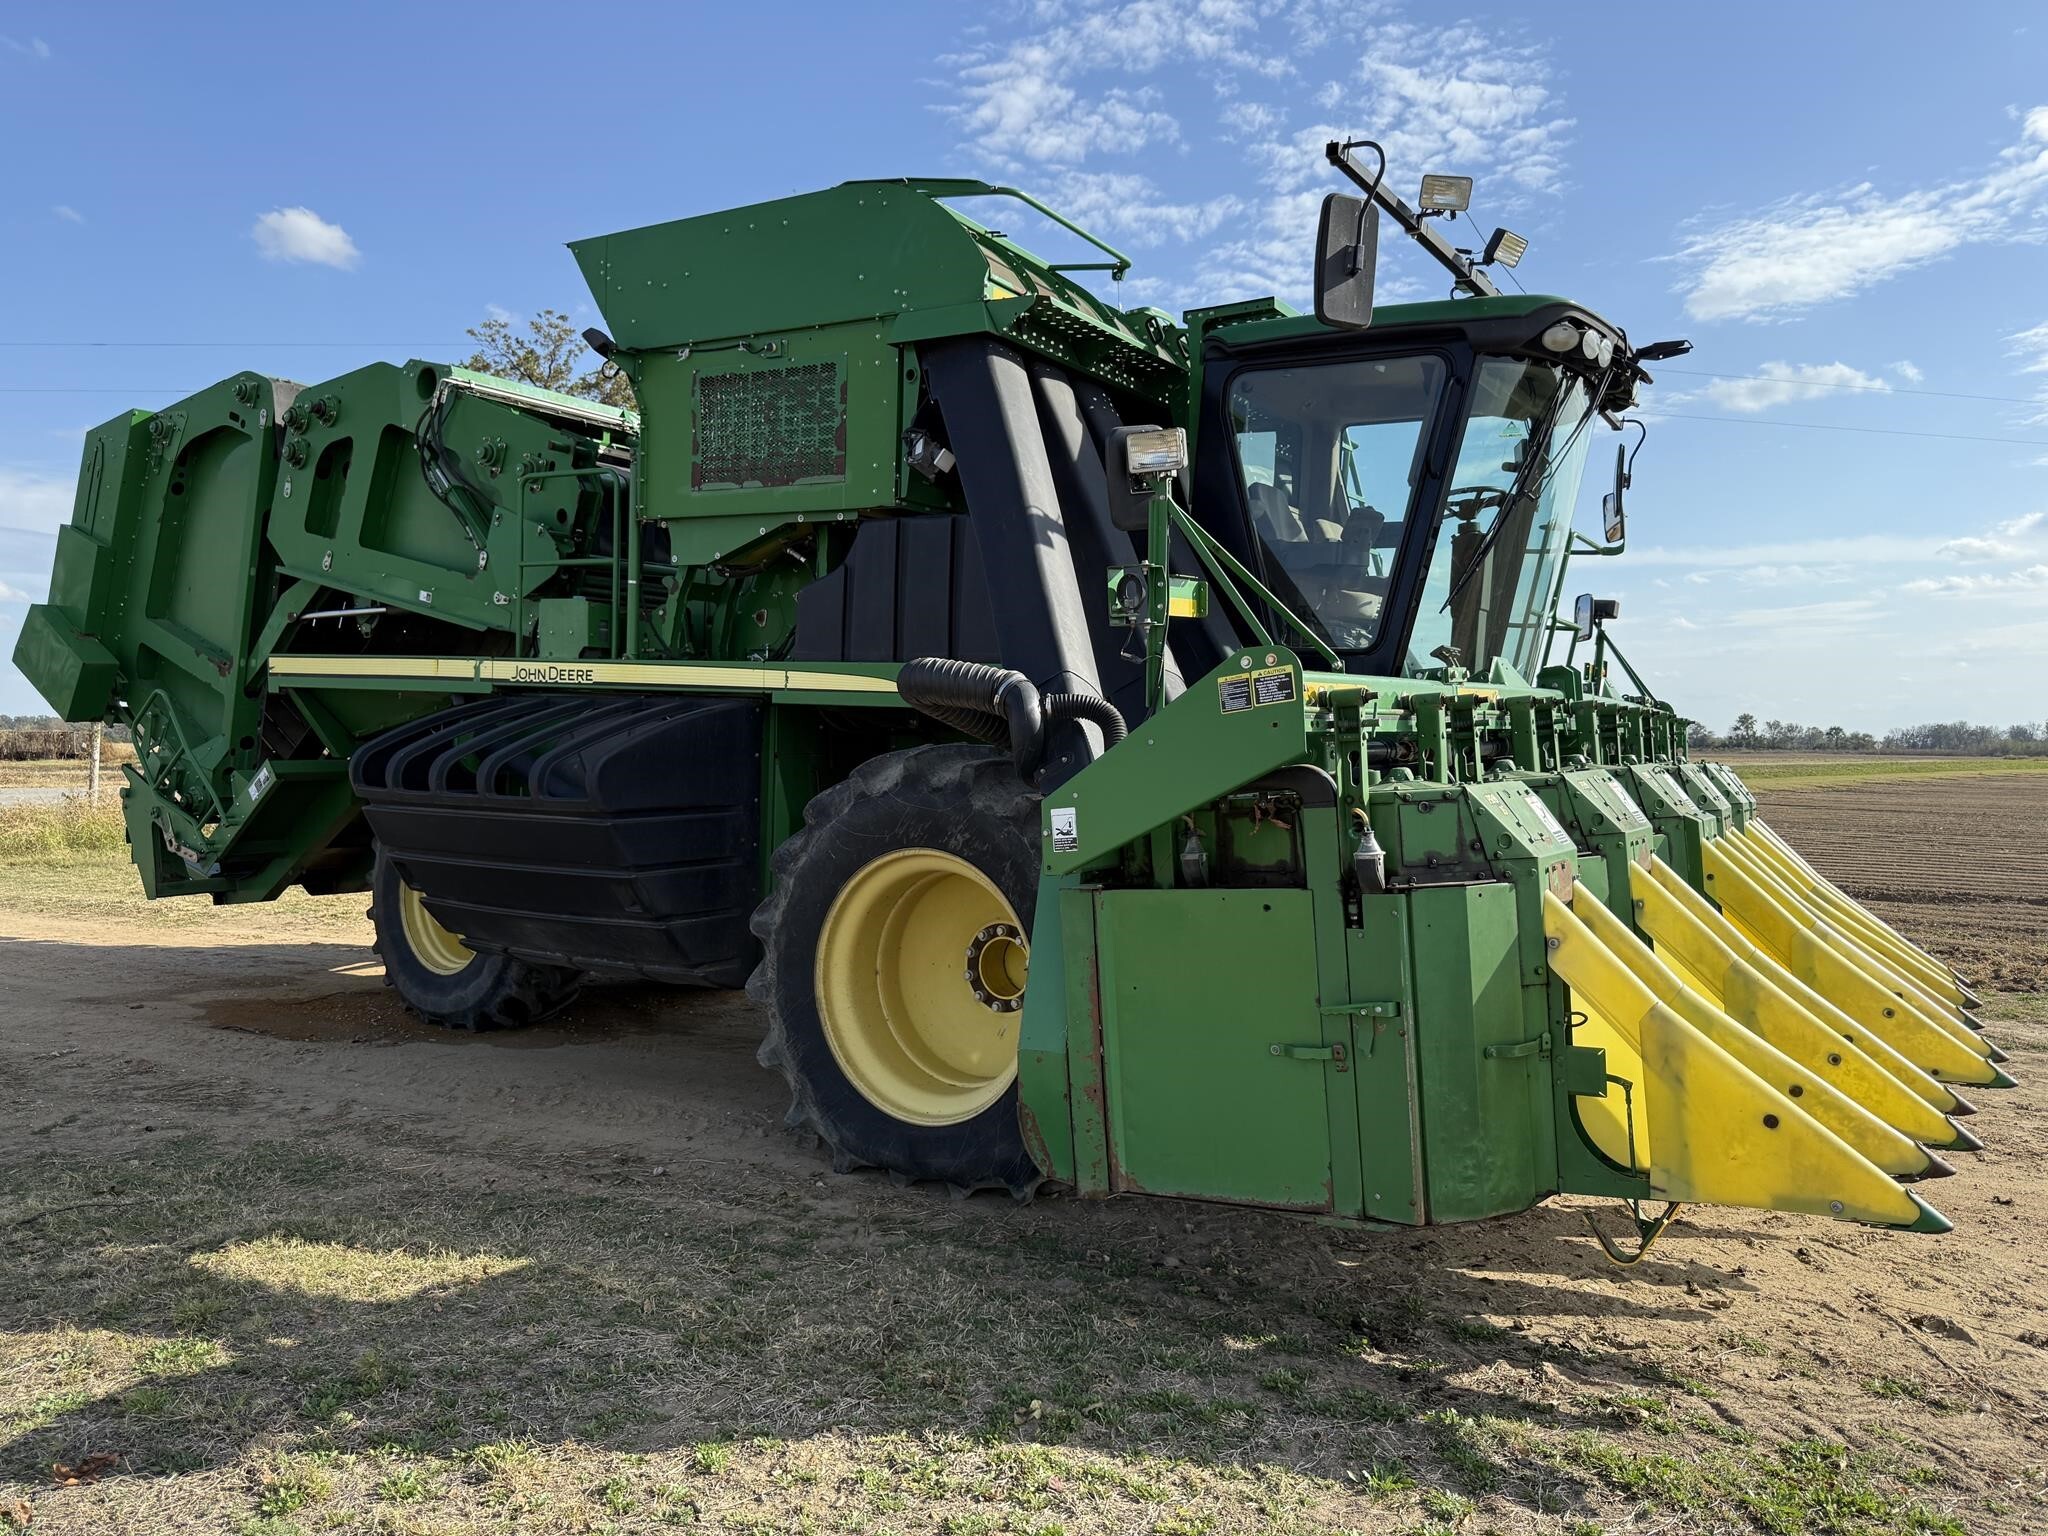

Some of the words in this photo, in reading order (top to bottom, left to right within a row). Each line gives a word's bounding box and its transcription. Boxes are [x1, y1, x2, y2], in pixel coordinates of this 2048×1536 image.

[511, 665, 546, 680] JOHN
[548, 666, 593, 681] DEERE
[1263, 668, 1287, 676] CAUTION
